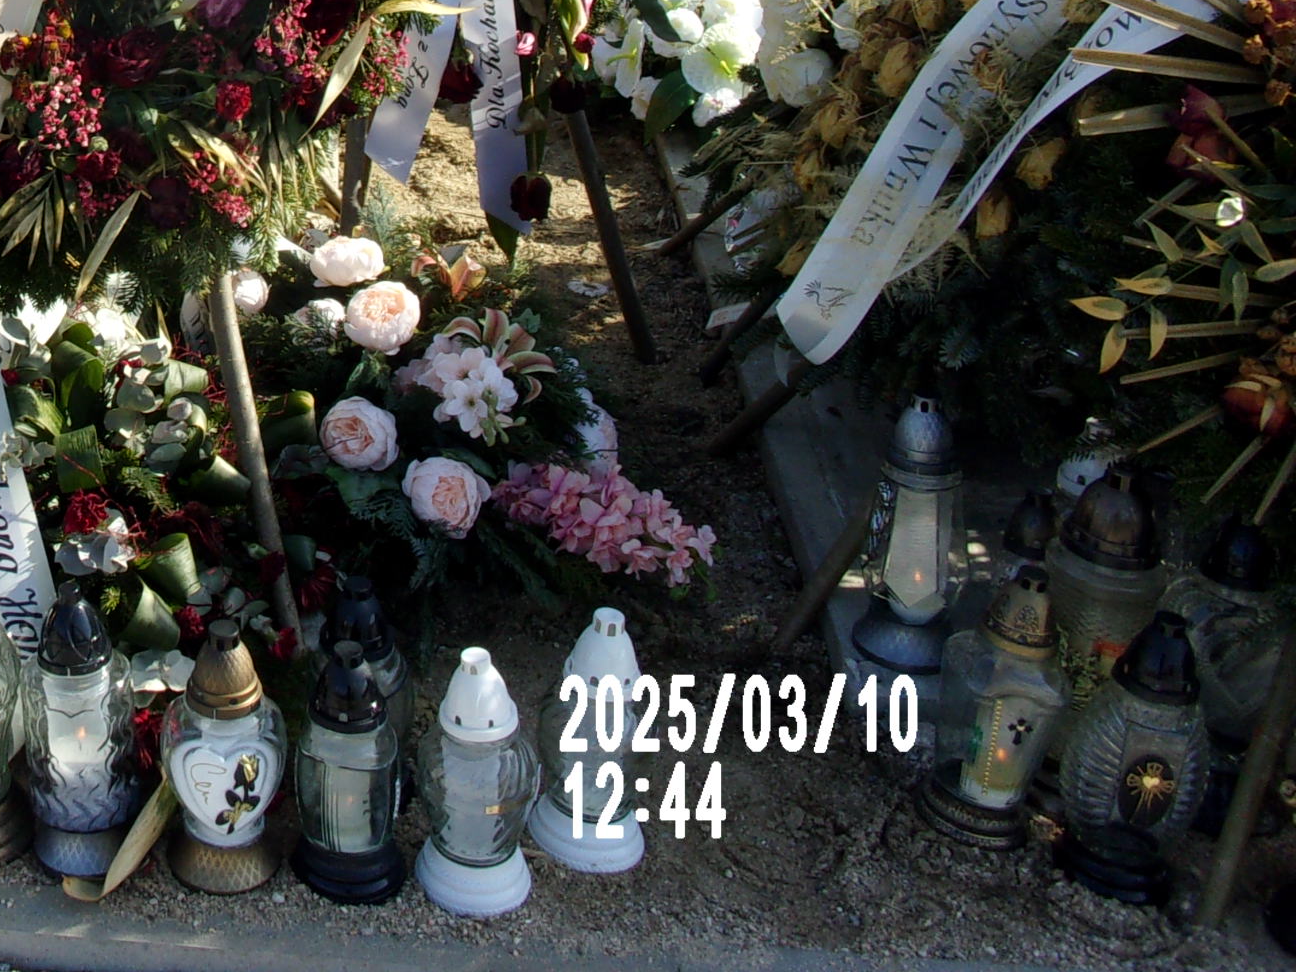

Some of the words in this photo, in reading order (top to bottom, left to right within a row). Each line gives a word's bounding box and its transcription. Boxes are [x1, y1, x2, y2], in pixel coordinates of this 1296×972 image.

[485, 85, 507, 129] Dla
[918, 115, 947, 136] i
[851, 143, 937, 246] Wnuka
